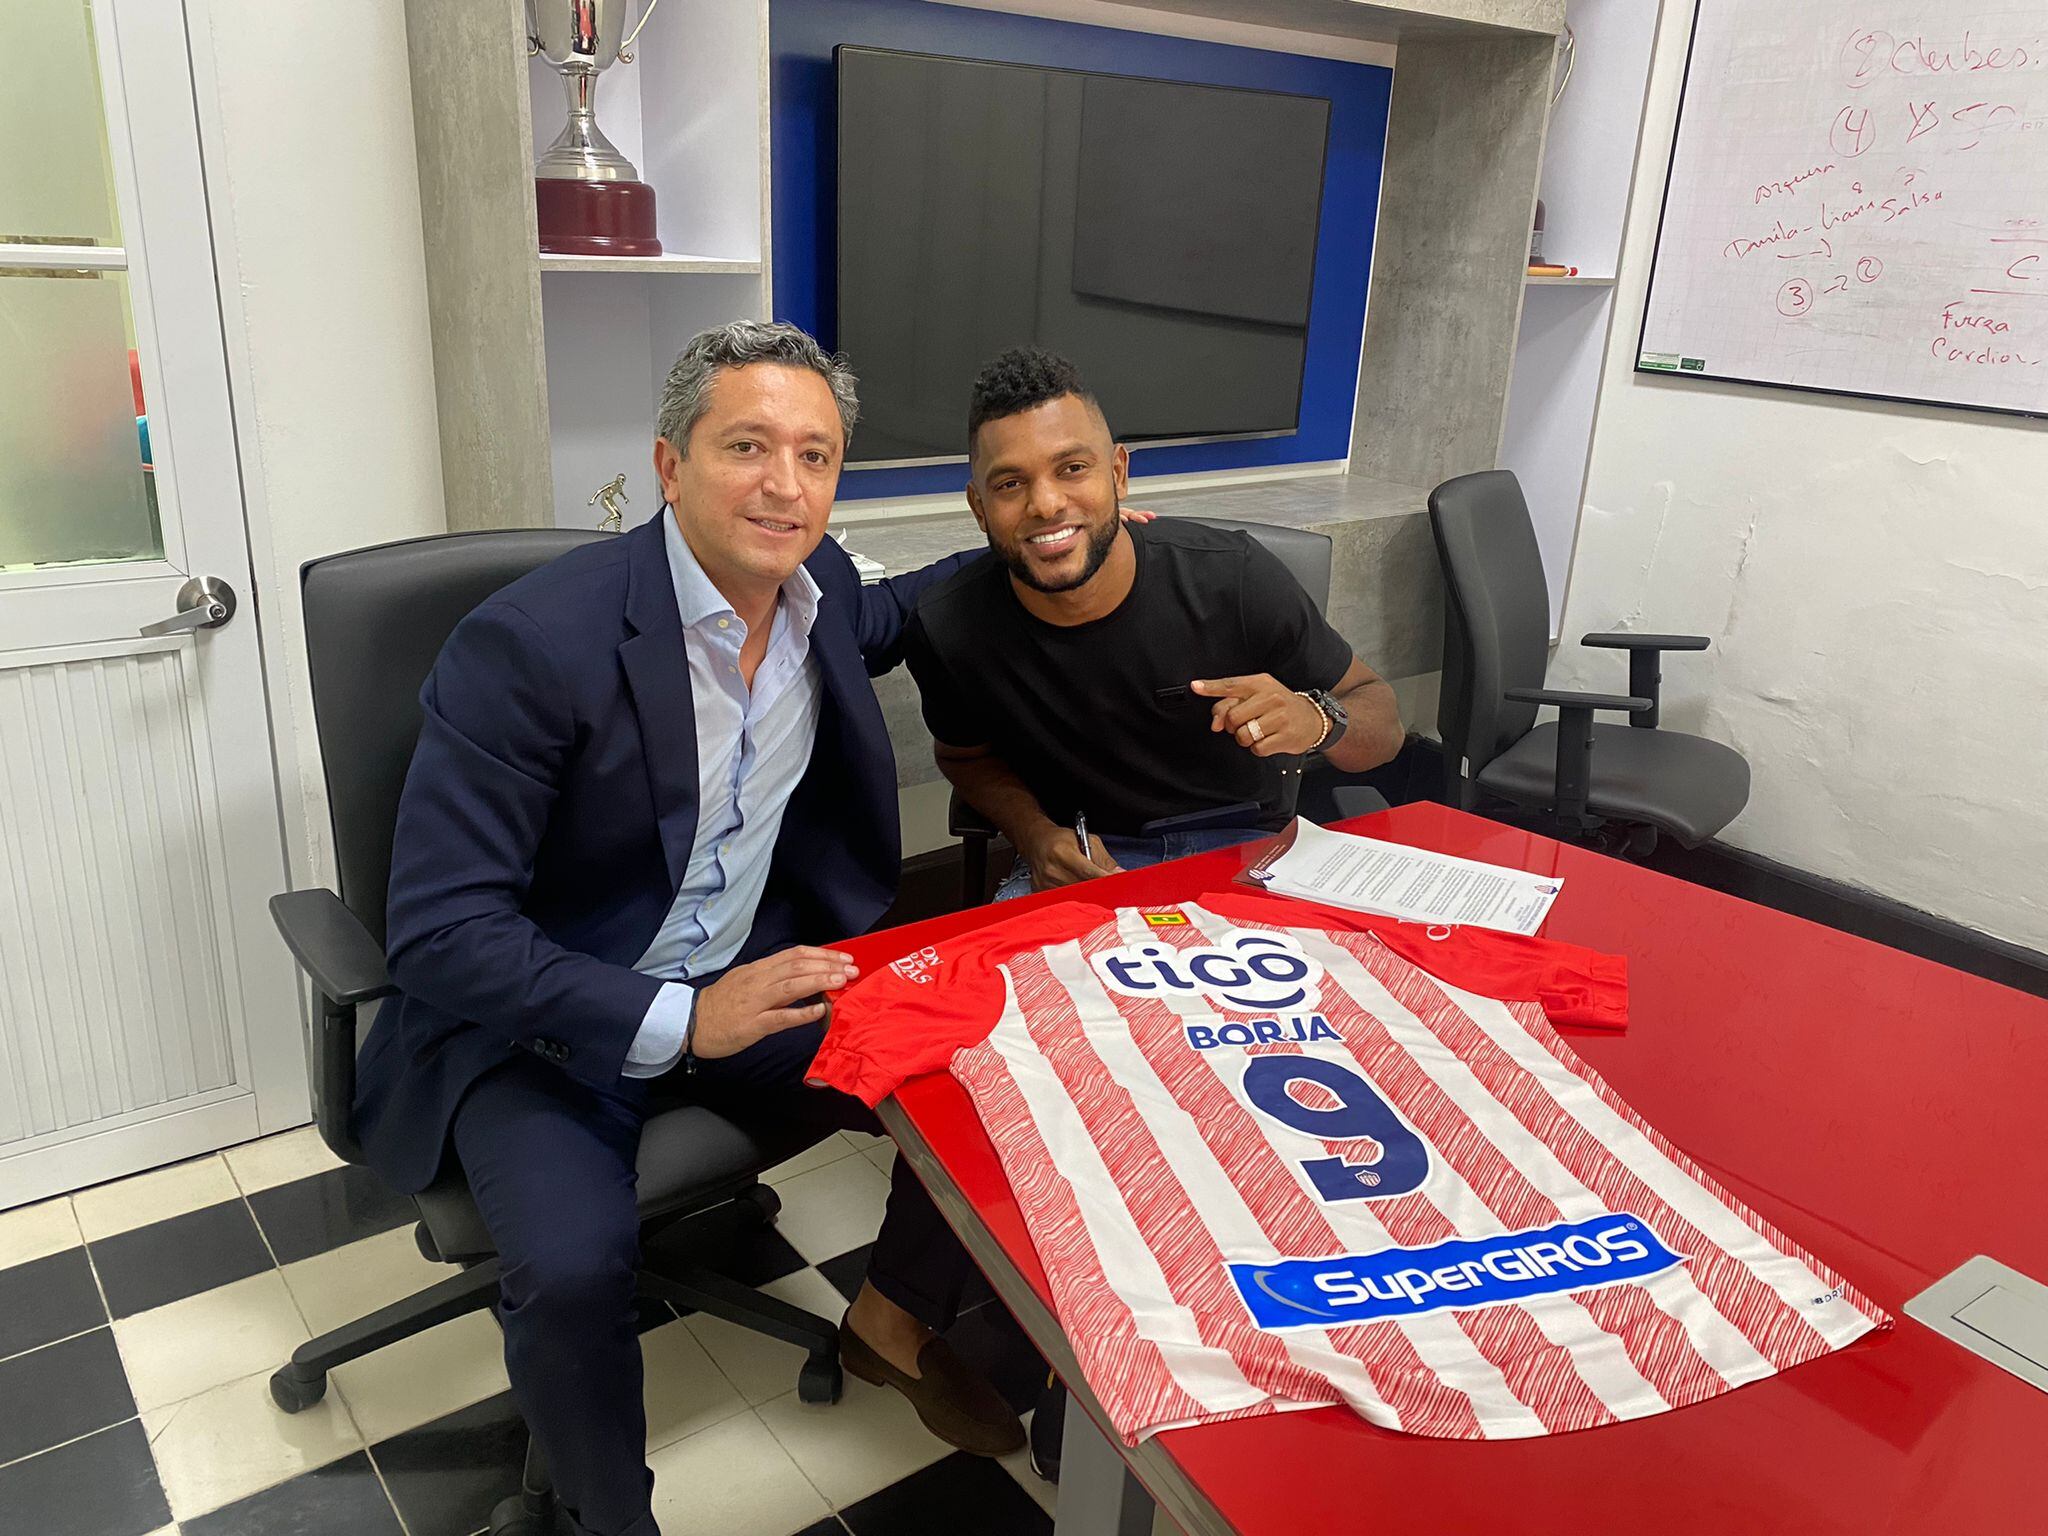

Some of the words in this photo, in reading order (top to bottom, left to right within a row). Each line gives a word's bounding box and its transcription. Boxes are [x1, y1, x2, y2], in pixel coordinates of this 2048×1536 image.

[895, 956, 934, 985] DAS
[920, 946, 945, 967] ON
[1187, 1015, 1342, 1050] BORJA
[1242, 1054, 1431, 1203] 9
[1824, 1284, 1844, 1303] DRY
